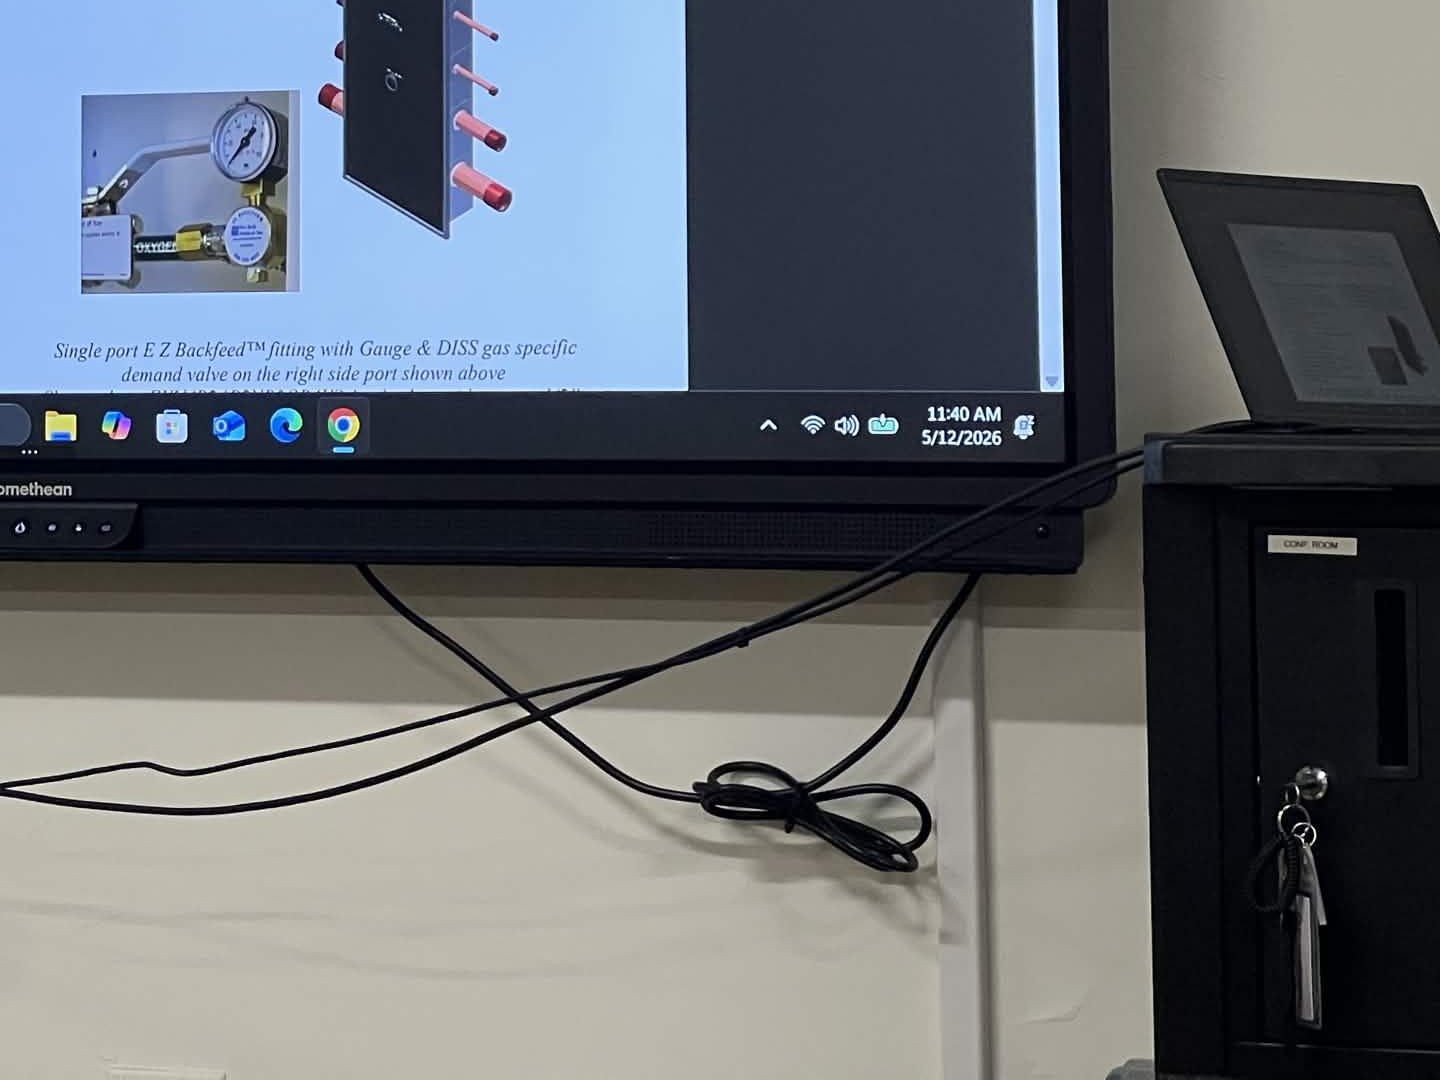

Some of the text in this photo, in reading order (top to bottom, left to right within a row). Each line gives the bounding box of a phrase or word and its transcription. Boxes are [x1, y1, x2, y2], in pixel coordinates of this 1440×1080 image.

[53, 341, 102, 363] Single
[105, 341, 138, 363] port
[142, 341, 156, 358] E
[158, 341, 172, 358] Z
[268, 340, 316, 362] fitting
[320, 340, 353, 357] with
[359, 339, 412, 361] Gauge
[416, 339, 430, 356] &
[436, 339, 479, 356] DISS
[481, 344, 511, 361] gas
[514, 339, 577, 361] specific
[120, 363, 506, 386] demand valve on the right side port shown above
[927, 406, 1002, 422] 11:40 AM
[921, 429, 1002, 446] 5/12/2026
